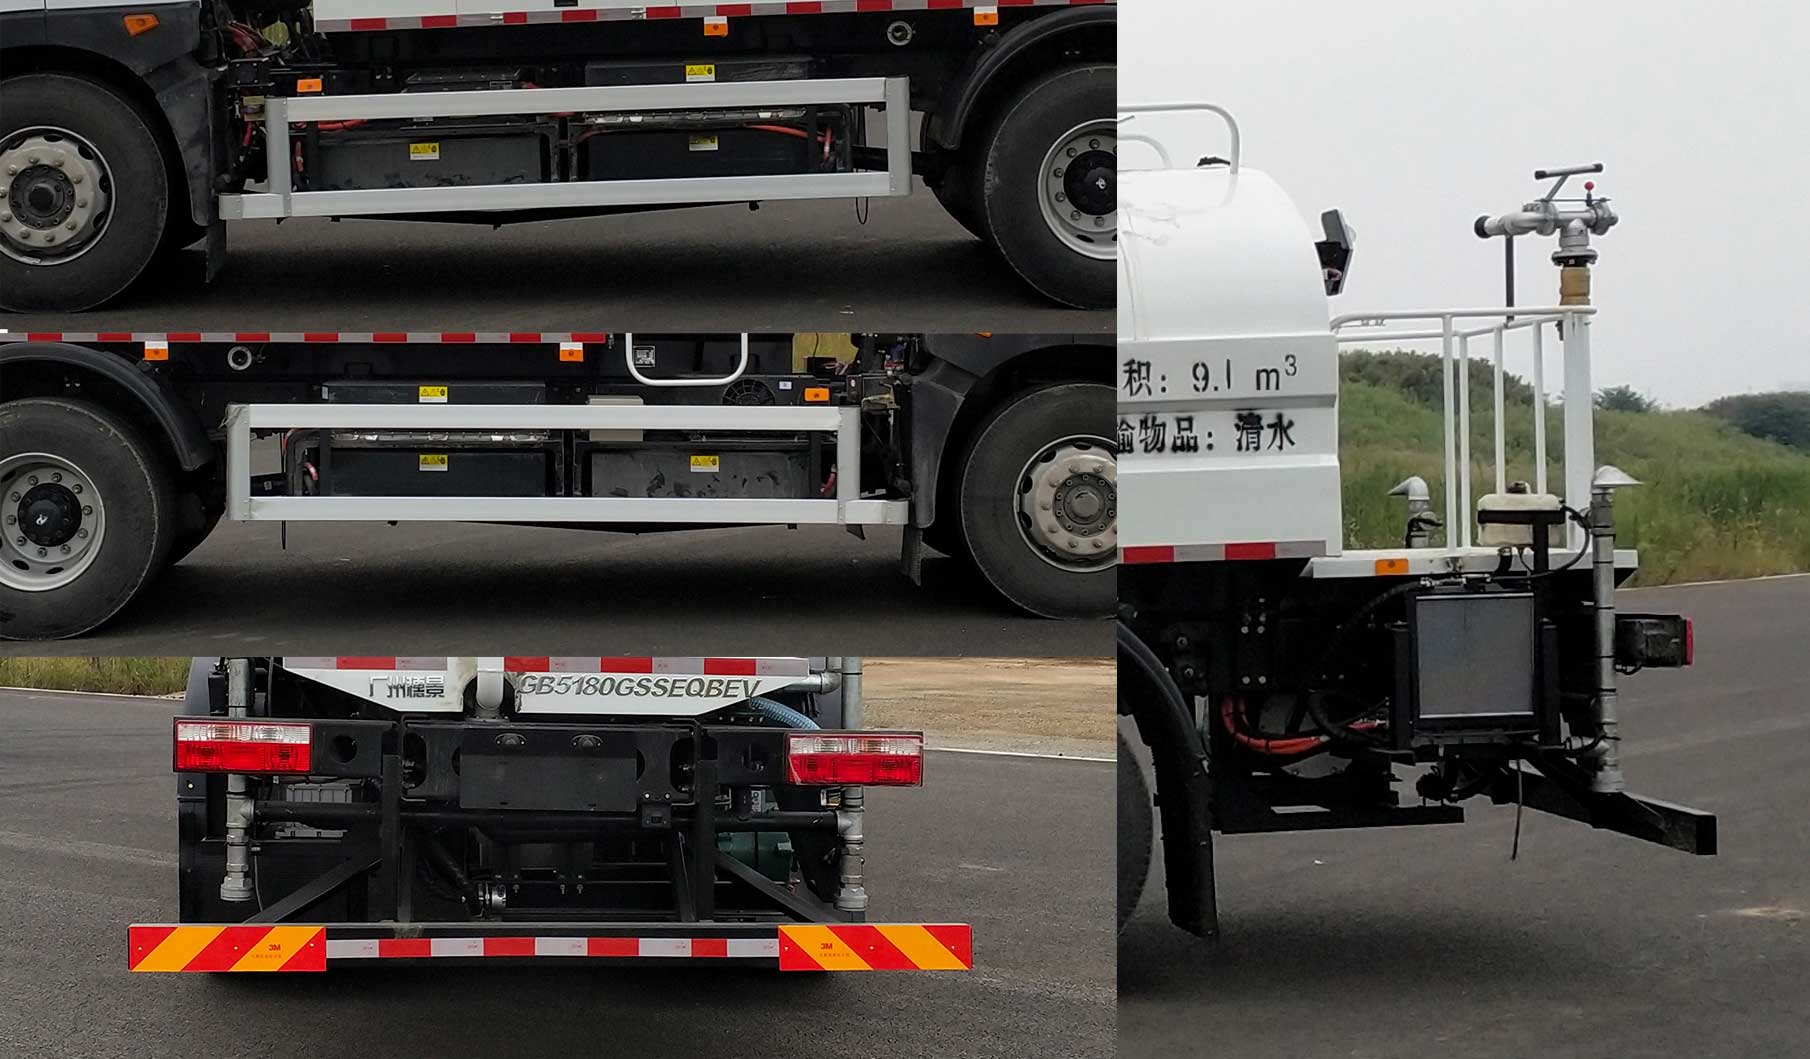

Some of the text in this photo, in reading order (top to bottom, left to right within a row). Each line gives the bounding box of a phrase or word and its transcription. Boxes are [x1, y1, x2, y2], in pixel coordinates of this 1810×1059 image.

[1192, 358, 1231, 393] 9.1
[1234, 411, 1296, 452] 清水
[519, 674, 761, 698] GB5180GSSEQBEV
[268, 943, 281, 951] 3M
[820, 942, 833, 950] 3M
